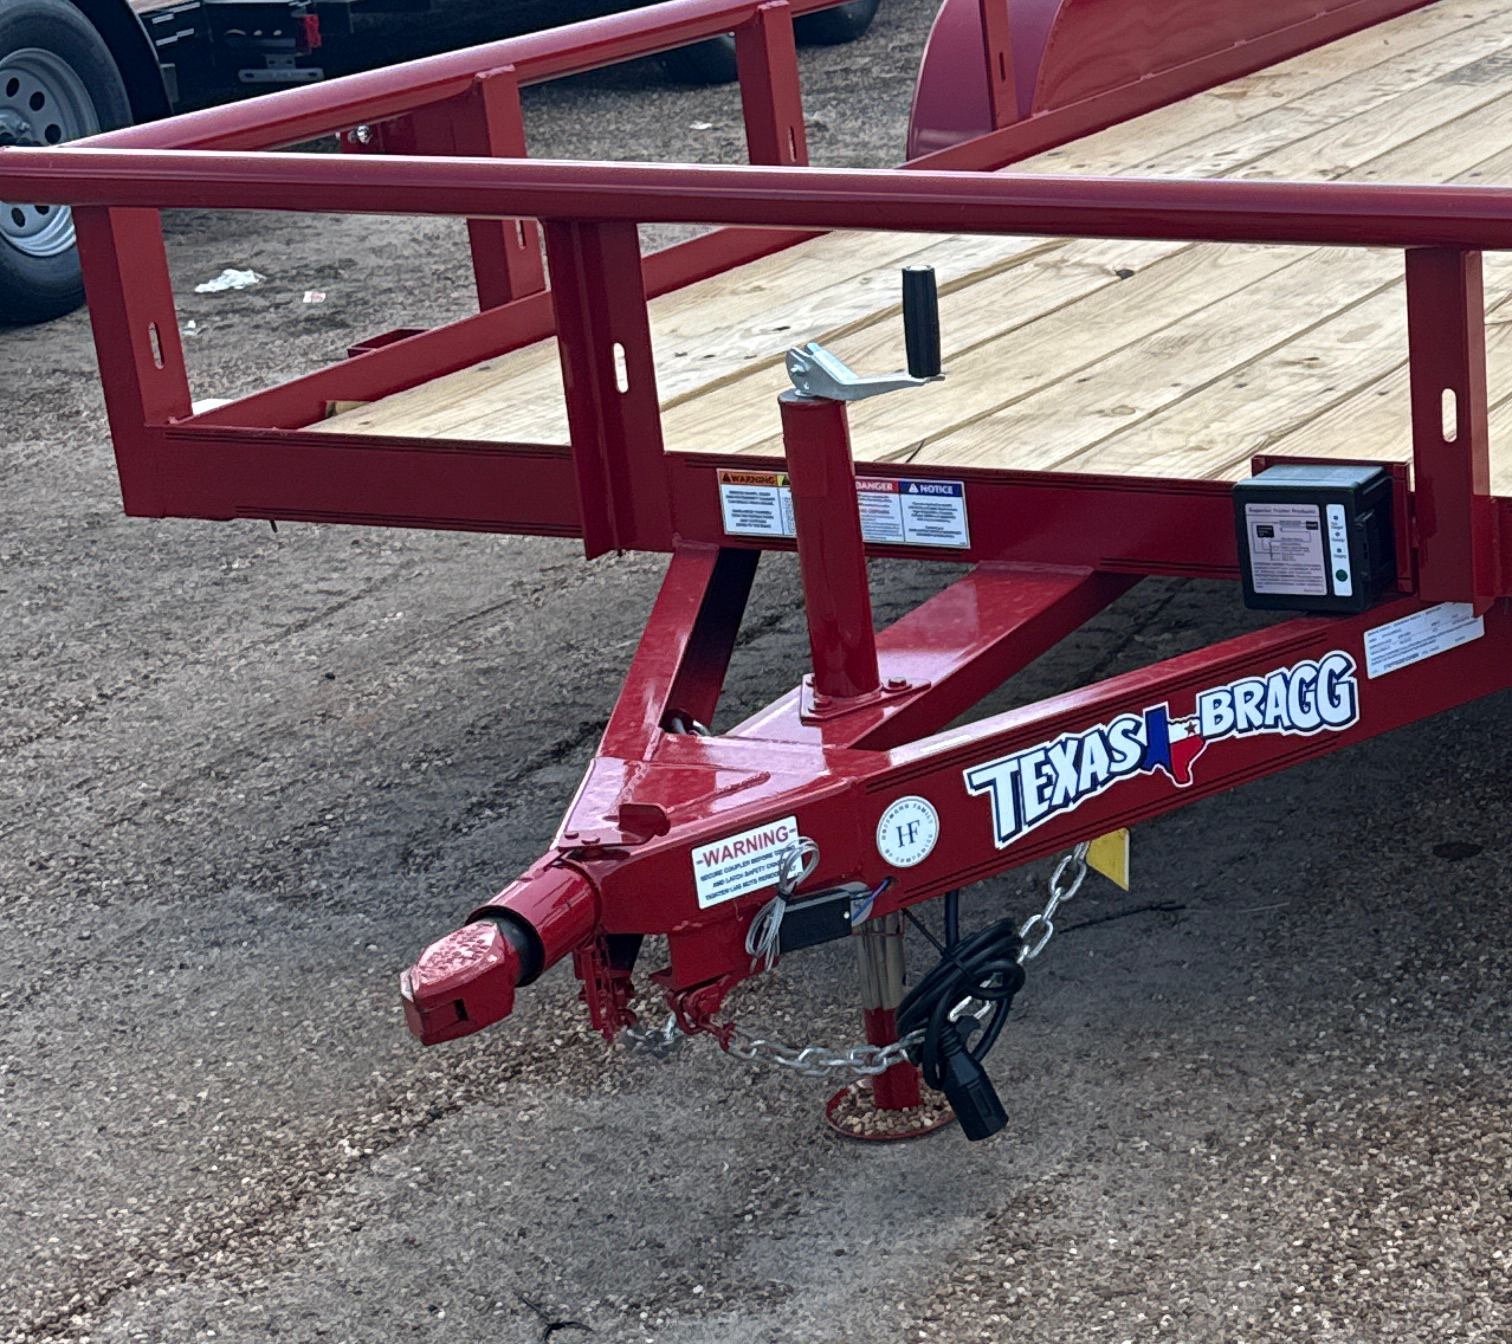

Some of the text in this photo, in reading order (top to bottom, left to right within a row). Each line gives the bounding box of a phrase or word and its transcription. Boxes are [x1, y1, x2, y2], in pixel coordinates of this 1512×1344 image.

[856, 481, 893, 491] DANGER
[920, 484, 953, 495] NOTICE
[963, 649, 1360, 849] TEXAS BRAGG
